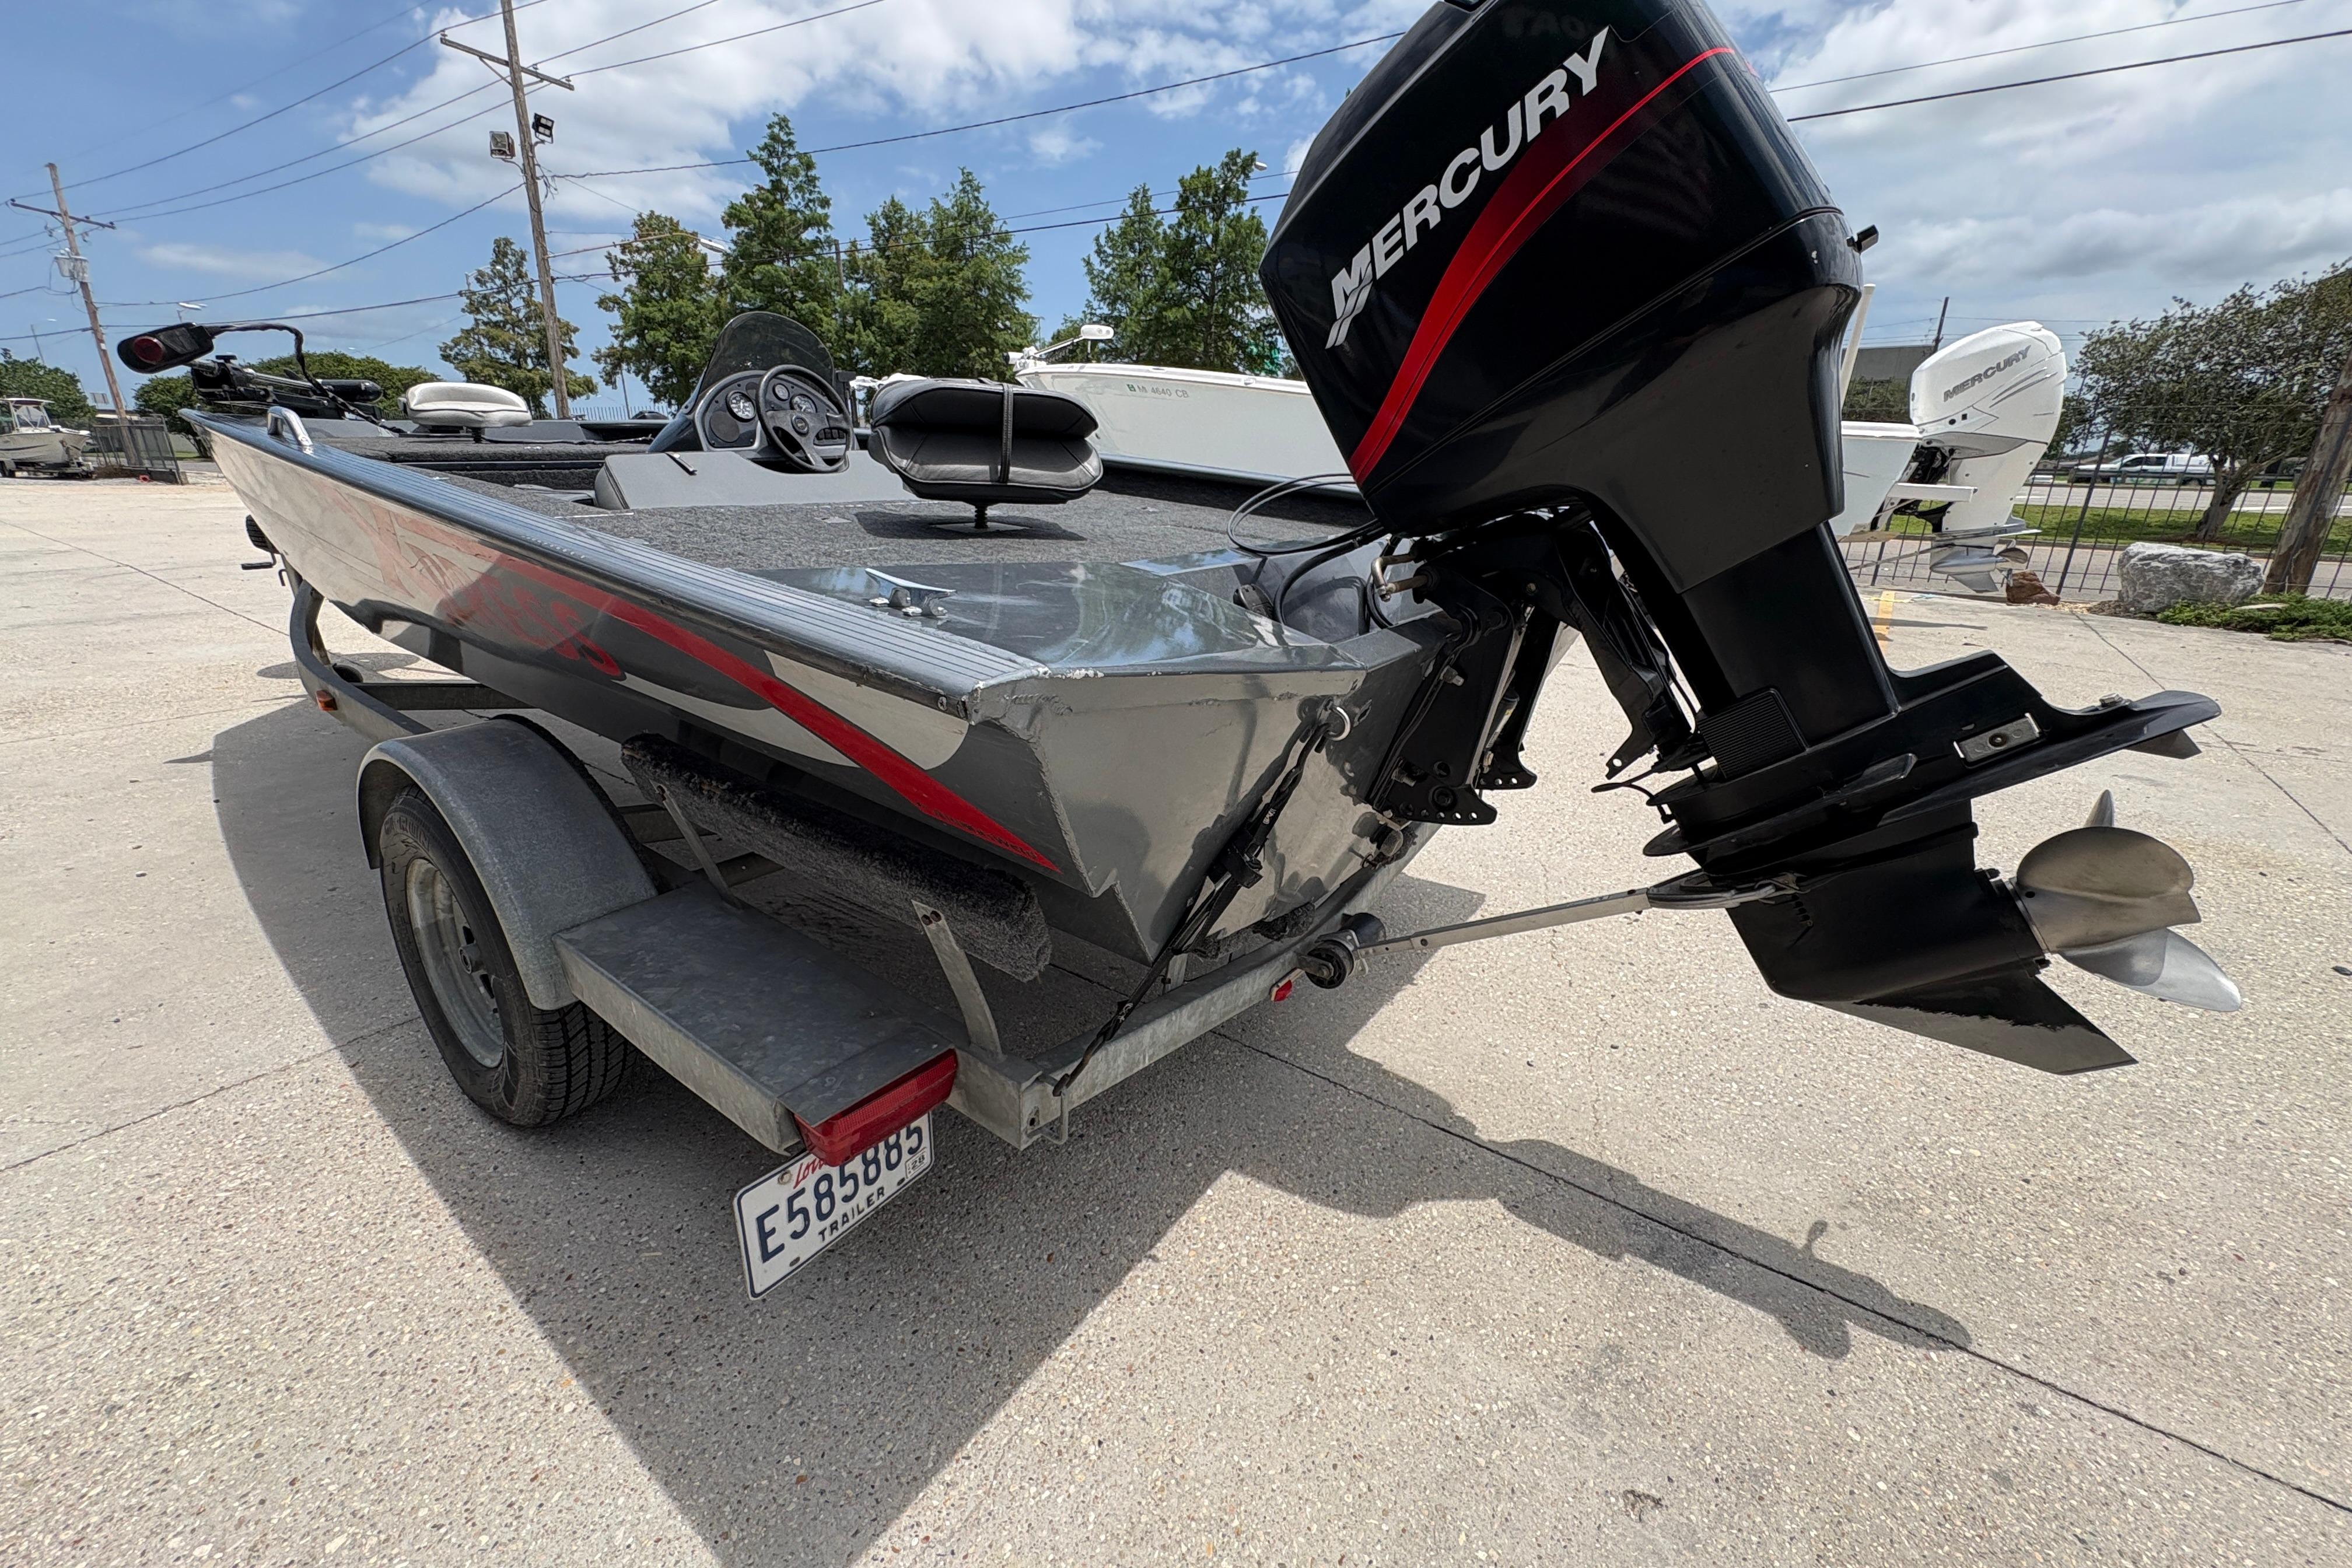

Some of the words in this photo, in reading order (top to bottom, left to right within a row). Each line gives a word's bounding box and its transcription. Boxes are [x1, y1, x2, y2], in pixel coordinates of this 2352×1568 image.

[1325, 24, 1611, 349] MERCURY
[1944, 345, 2031, 402] MERCURY
[756, 1126, 923, 1264] E585885
[818, 1186, 886, 1242] TRAILER
